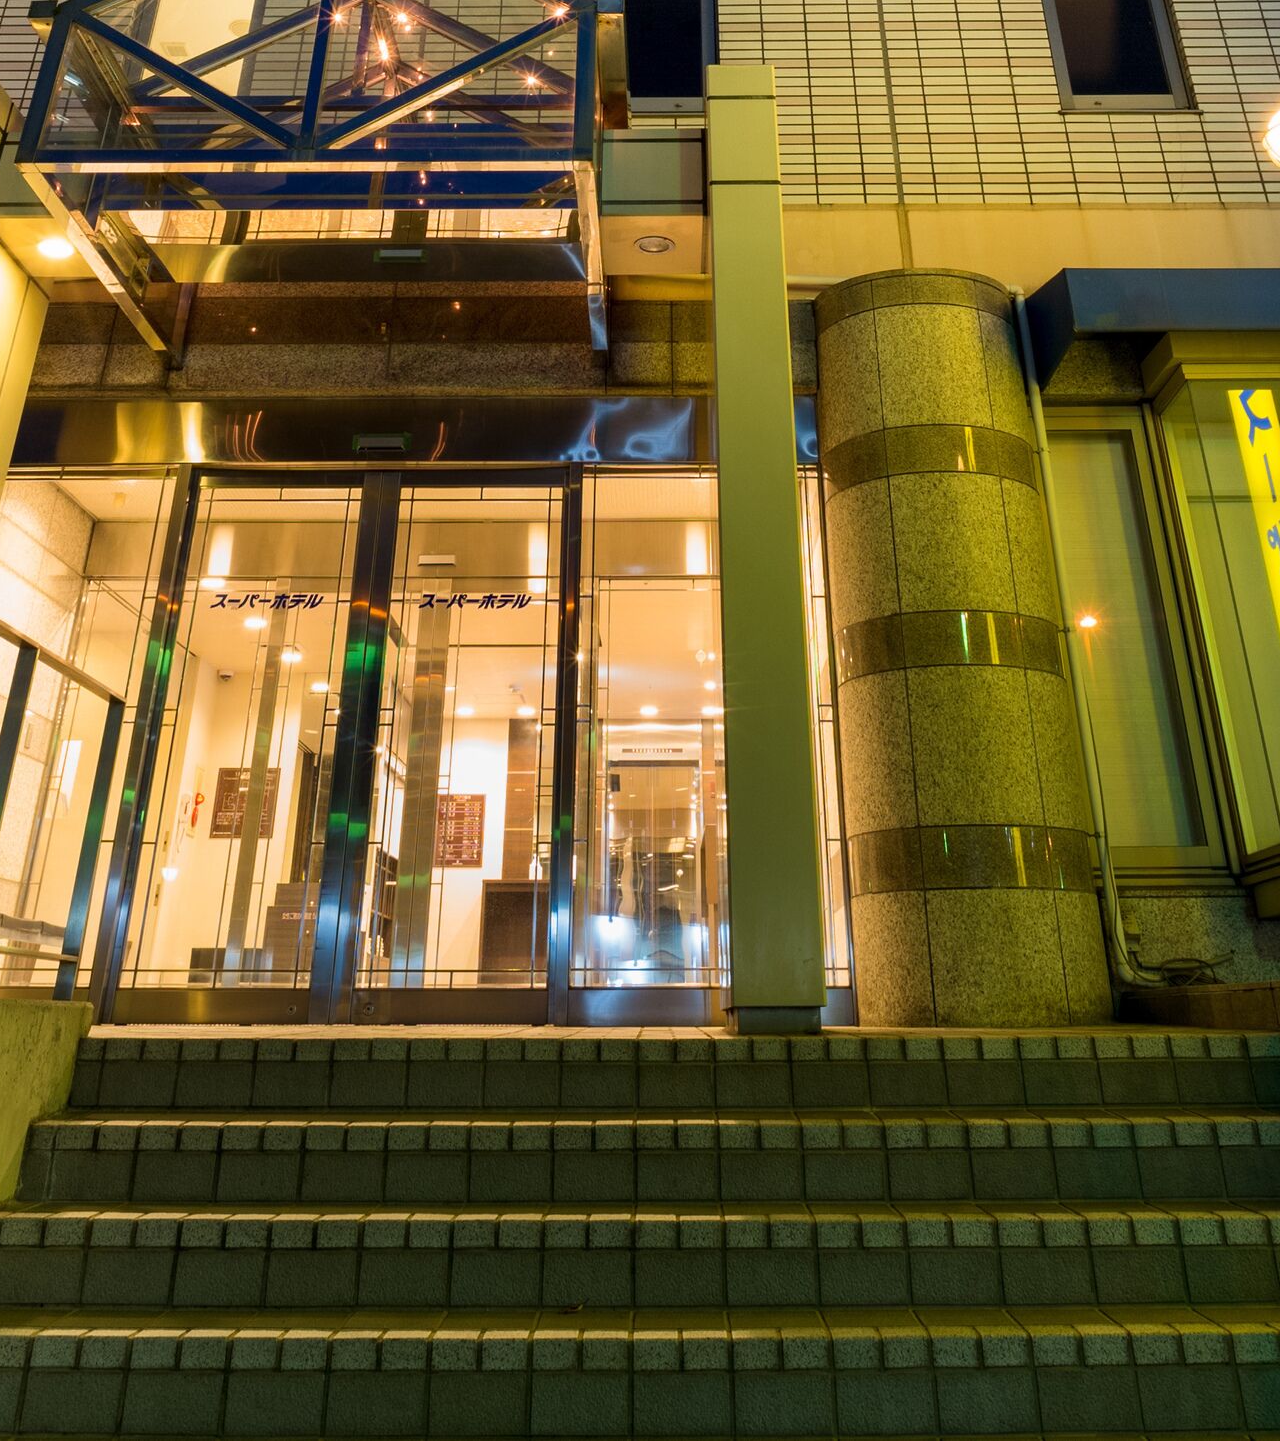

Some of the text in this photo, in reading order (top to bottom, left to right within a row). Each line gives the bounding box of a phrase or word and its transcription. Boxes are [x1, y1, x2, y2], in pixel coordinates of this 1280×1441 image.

[210, 593, 324, 610] スーパーホテル
[418, 593, 532, 610] スーパーホテル
